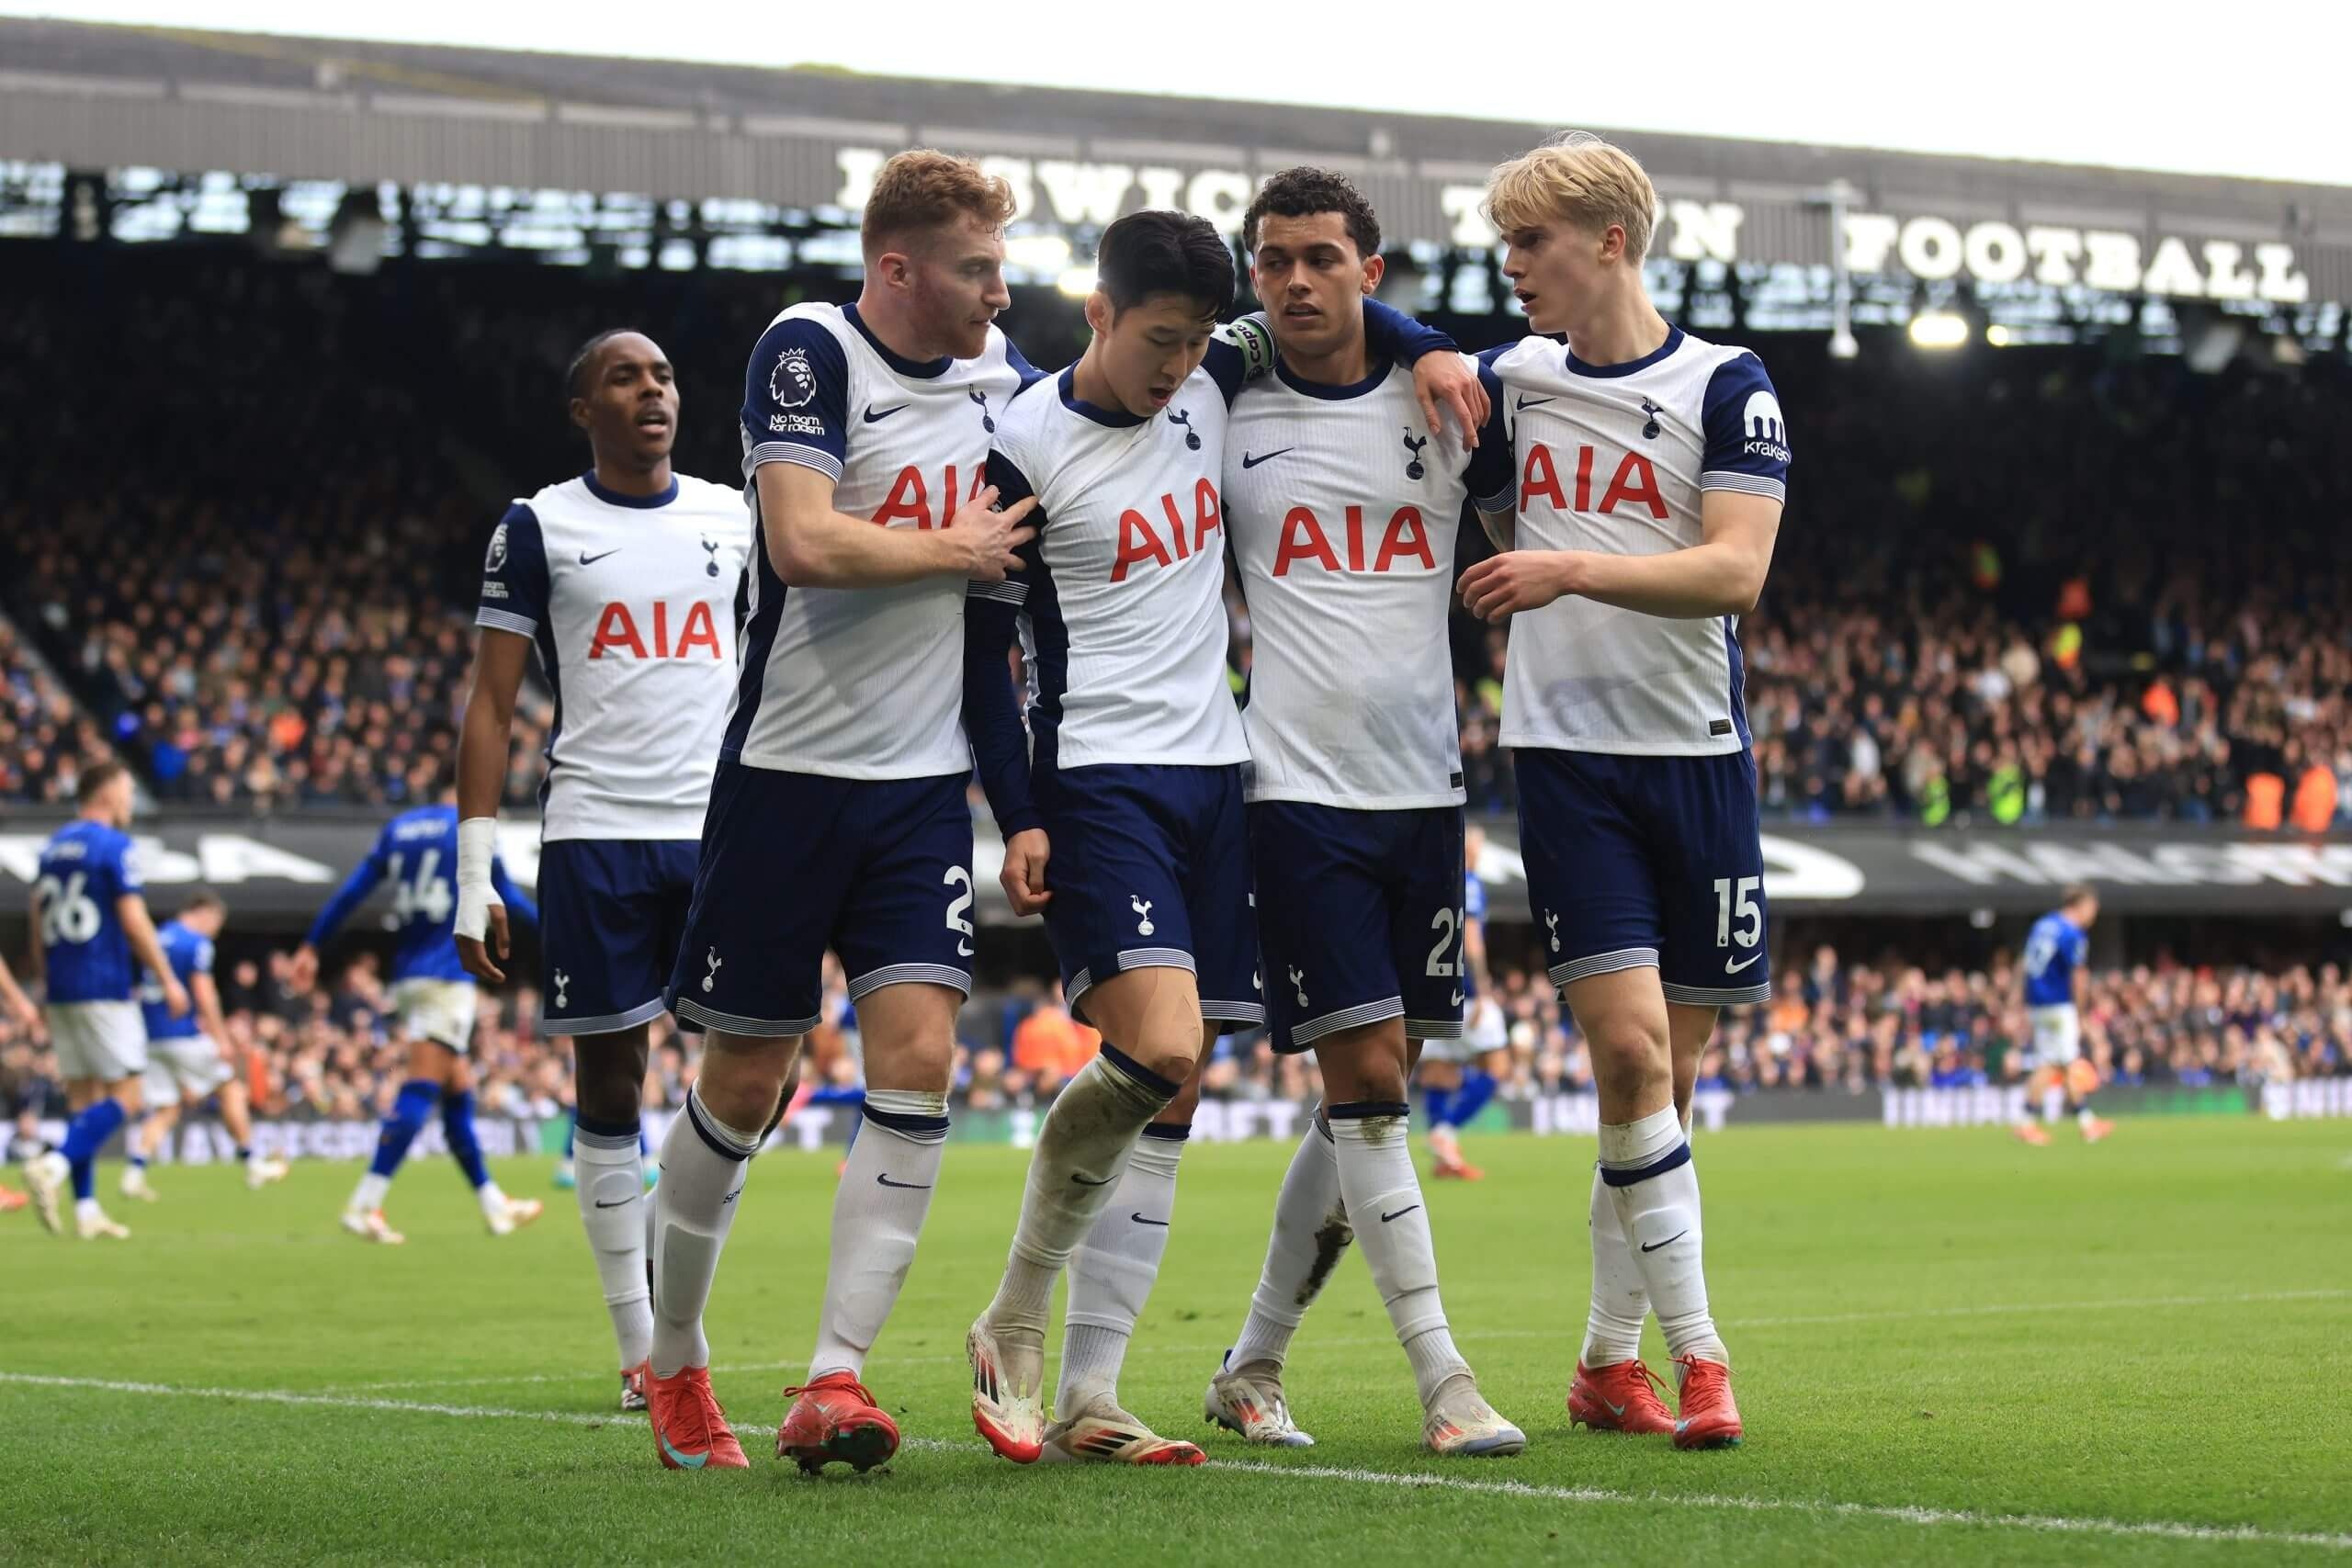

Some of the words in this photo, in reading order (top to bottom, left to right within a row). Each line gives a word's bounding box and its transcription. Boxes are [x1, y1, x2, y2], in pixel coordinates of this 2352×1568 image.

[835, 147, 1253, 234] ISWIC
[1440, 185, 1746, 265] TN
[1841, 212, 2311, 302] FOOTBALL
[1236, 324, 1262, 365] capt
[771, 412, 787, 423] No
[788, 413, 820, 426] room
[787, 423, 825, 436] racism
[1519, 444, 1669, 519] AIA
[1109, 476, 1223, 583] AIA
[1272, 504, 1436, 578] AIA
[587, 600, 722, 660] AIA
[1713, 875, 1762, 948] 15
